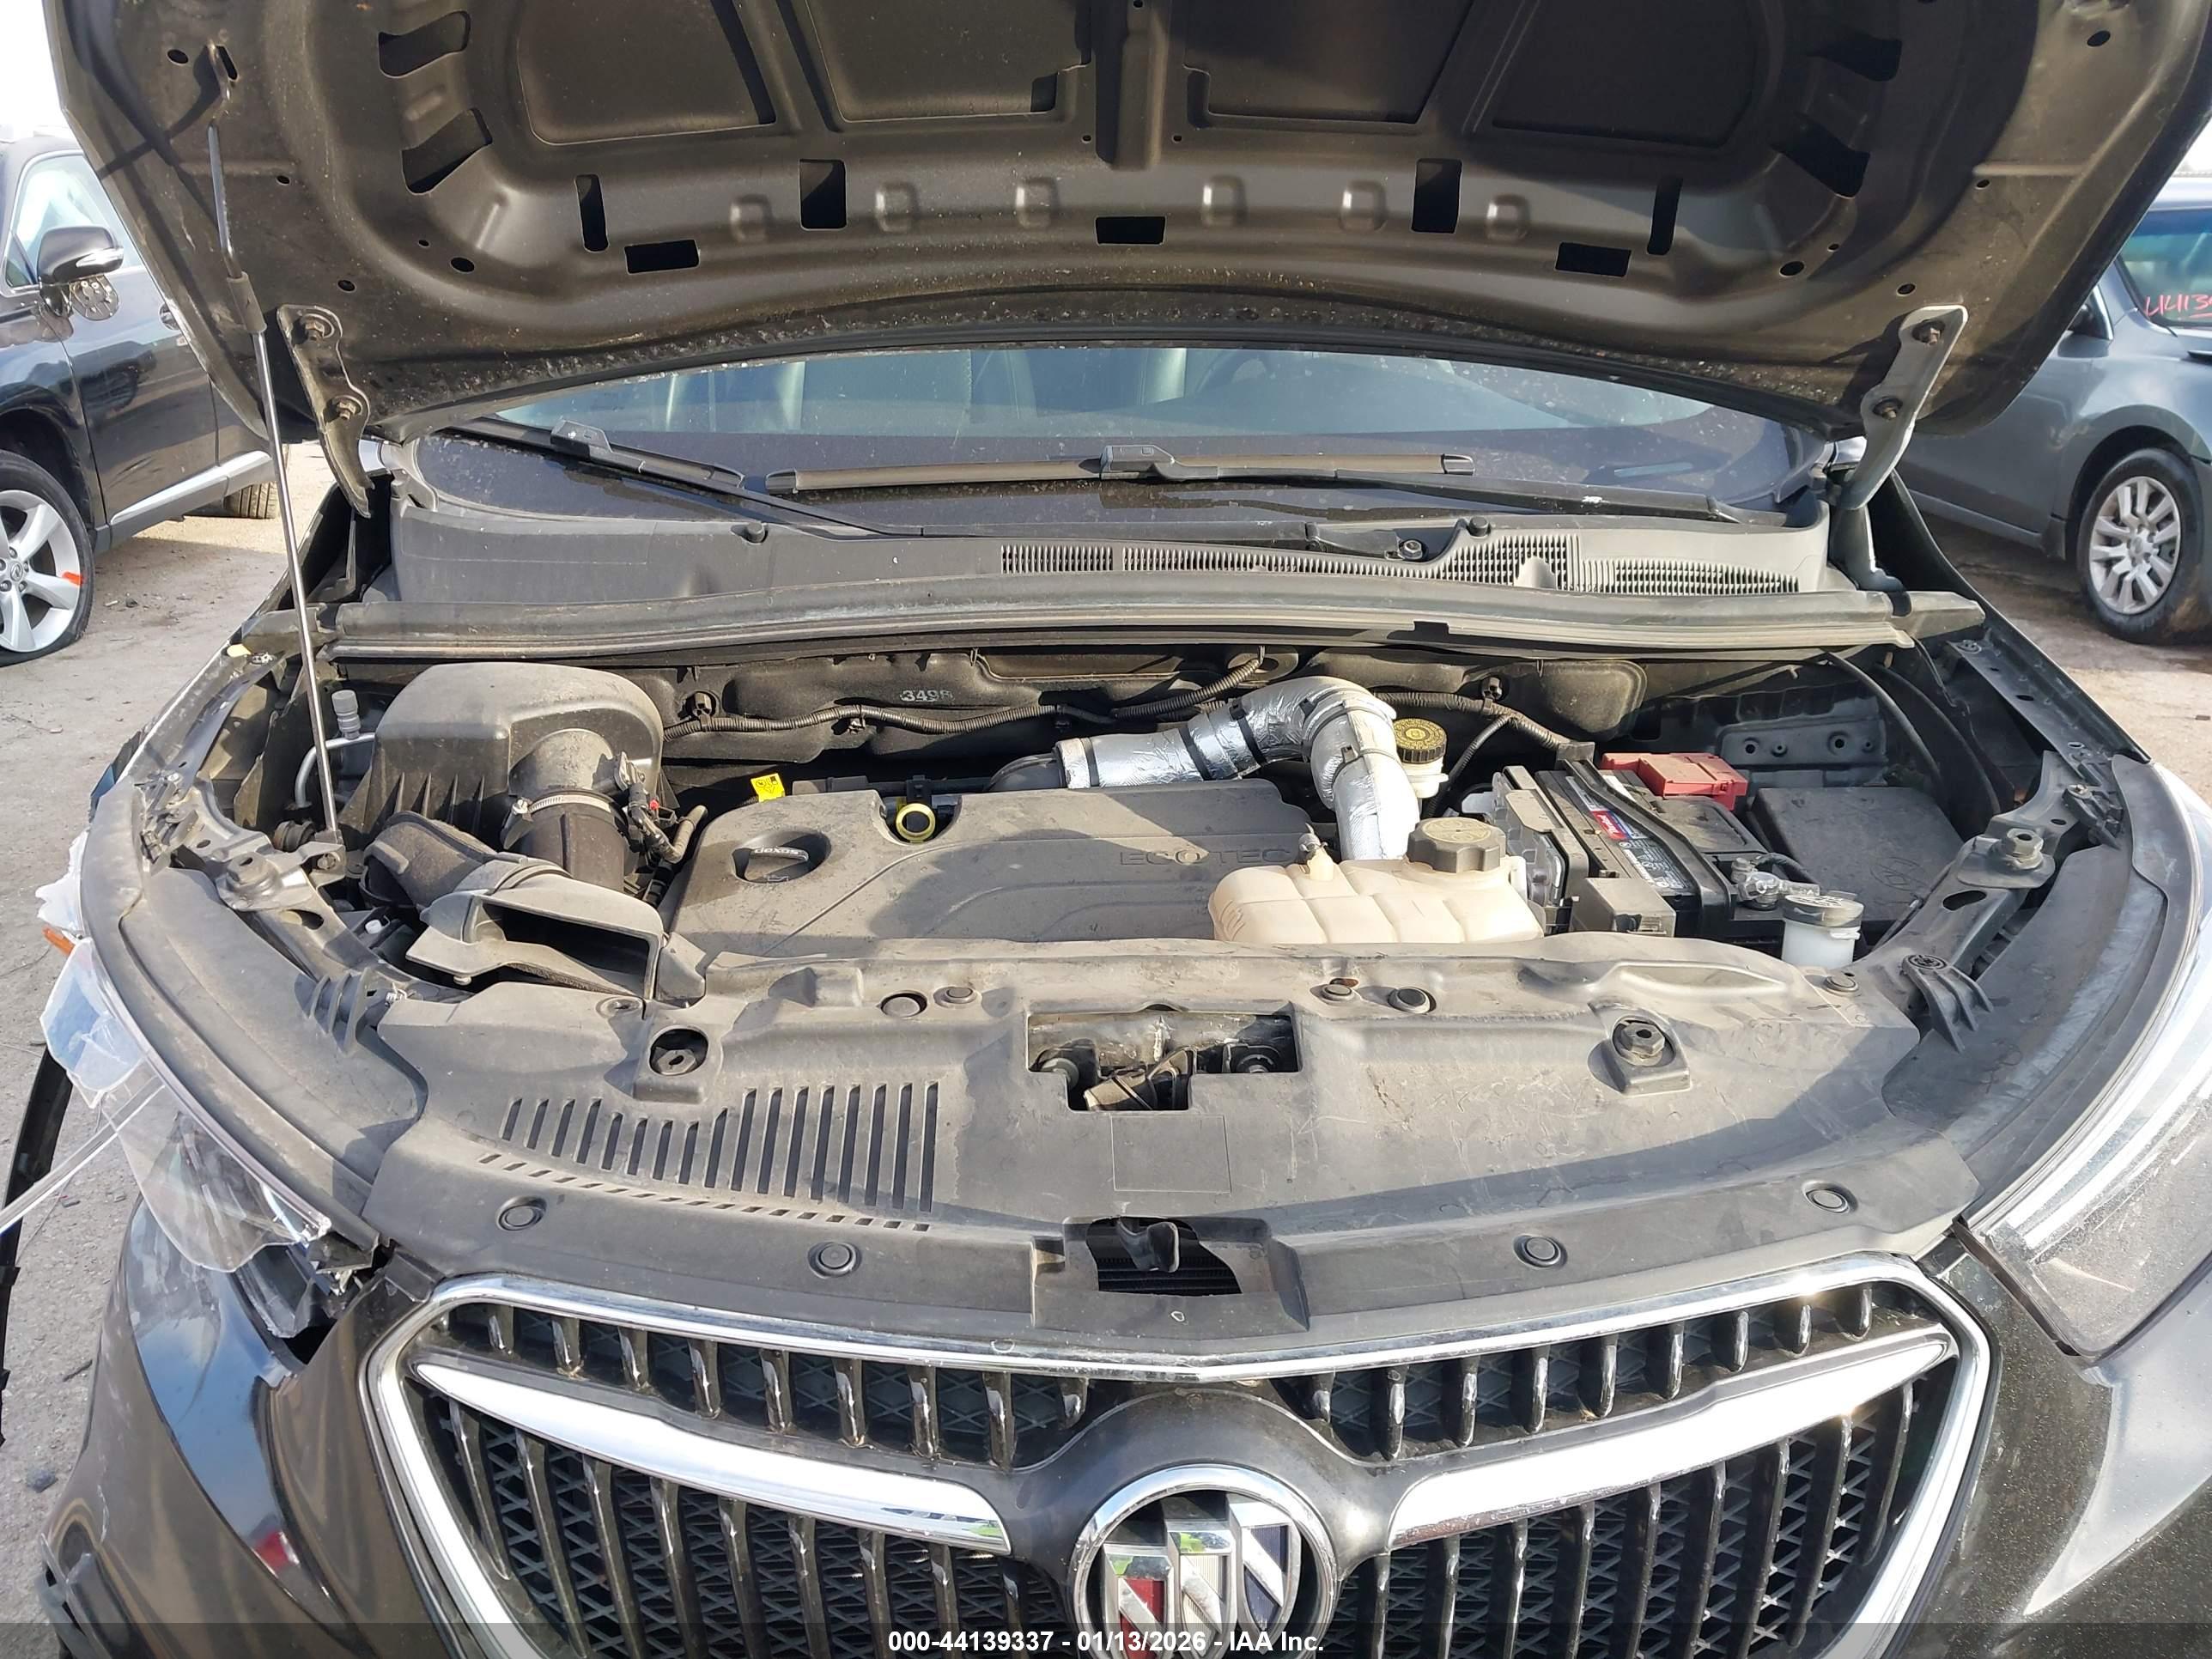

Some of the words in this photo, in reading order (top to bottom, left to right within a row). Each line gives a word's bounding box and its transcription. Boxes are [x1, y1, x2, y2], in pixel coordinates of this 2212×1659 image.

[2146, 294, 2212, 316] 4413
[754, 846, 799, 855] dexos
[1120, 848, 1291, 866] ECOTEC
